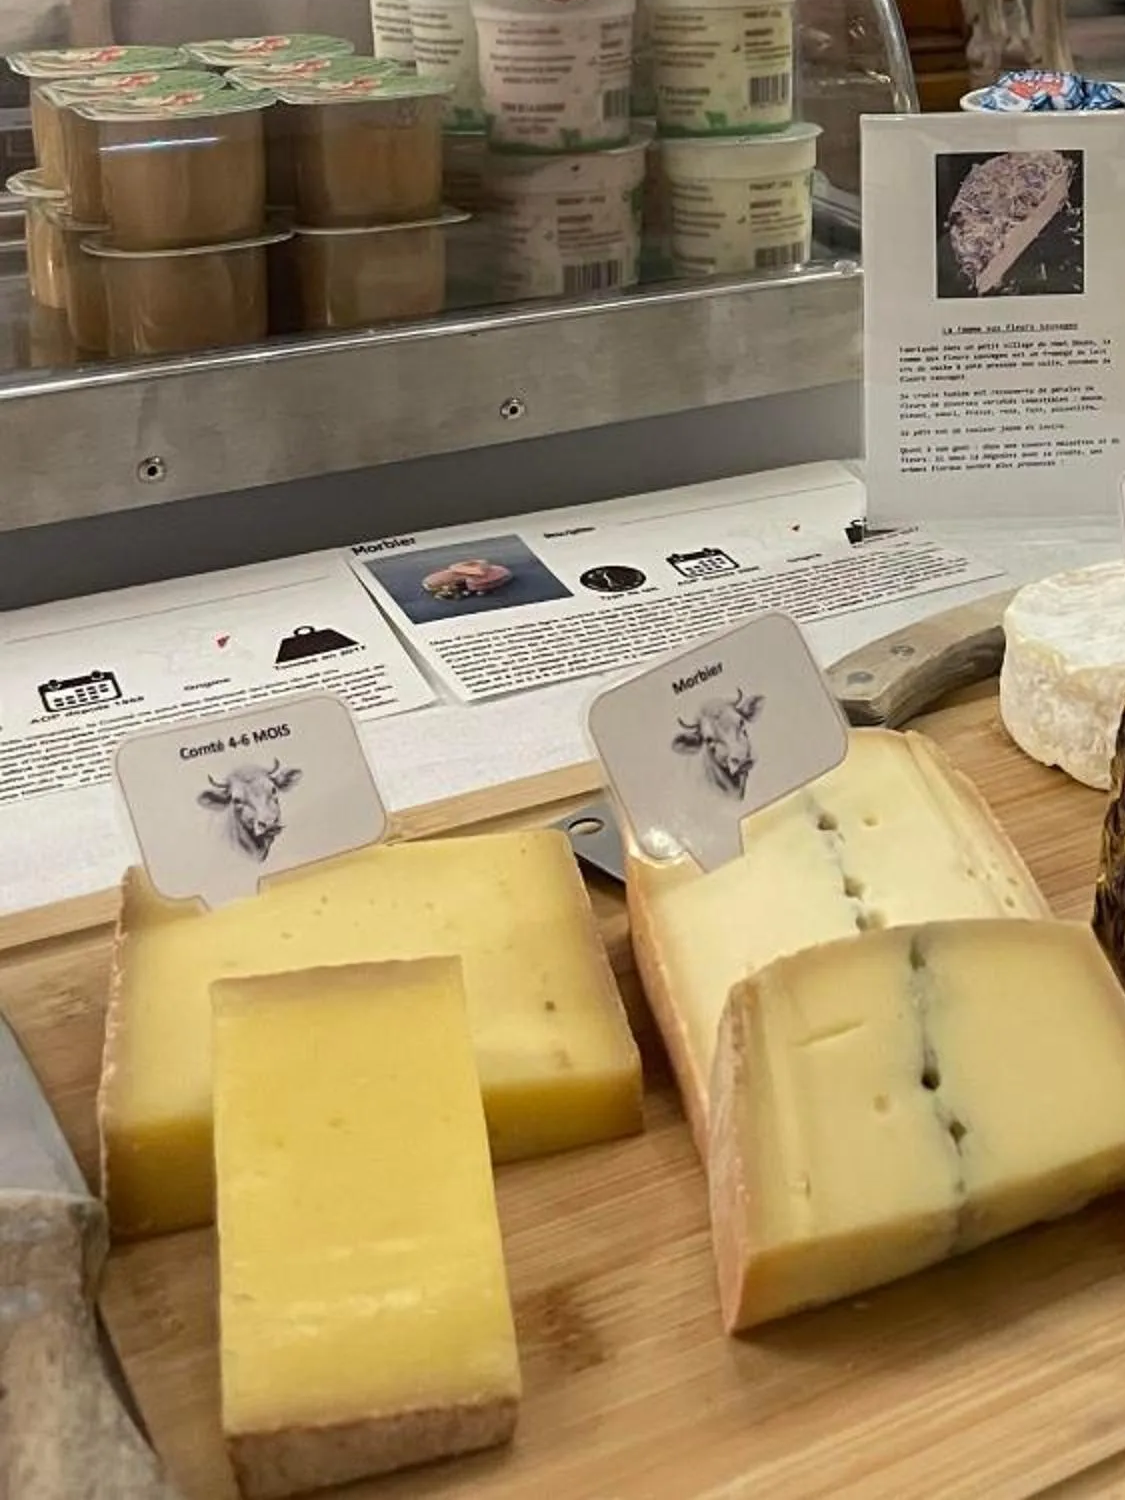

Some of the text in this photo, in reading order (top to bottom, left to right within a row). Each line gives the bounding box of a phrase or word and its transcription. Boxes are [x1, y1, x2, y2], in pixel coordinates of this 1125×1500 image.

[351, 537, 416, 556] Morbier
[672, 661, 723, 695] Morbier
[180, 723, 291, 760] Comté 4-6 MOIS
